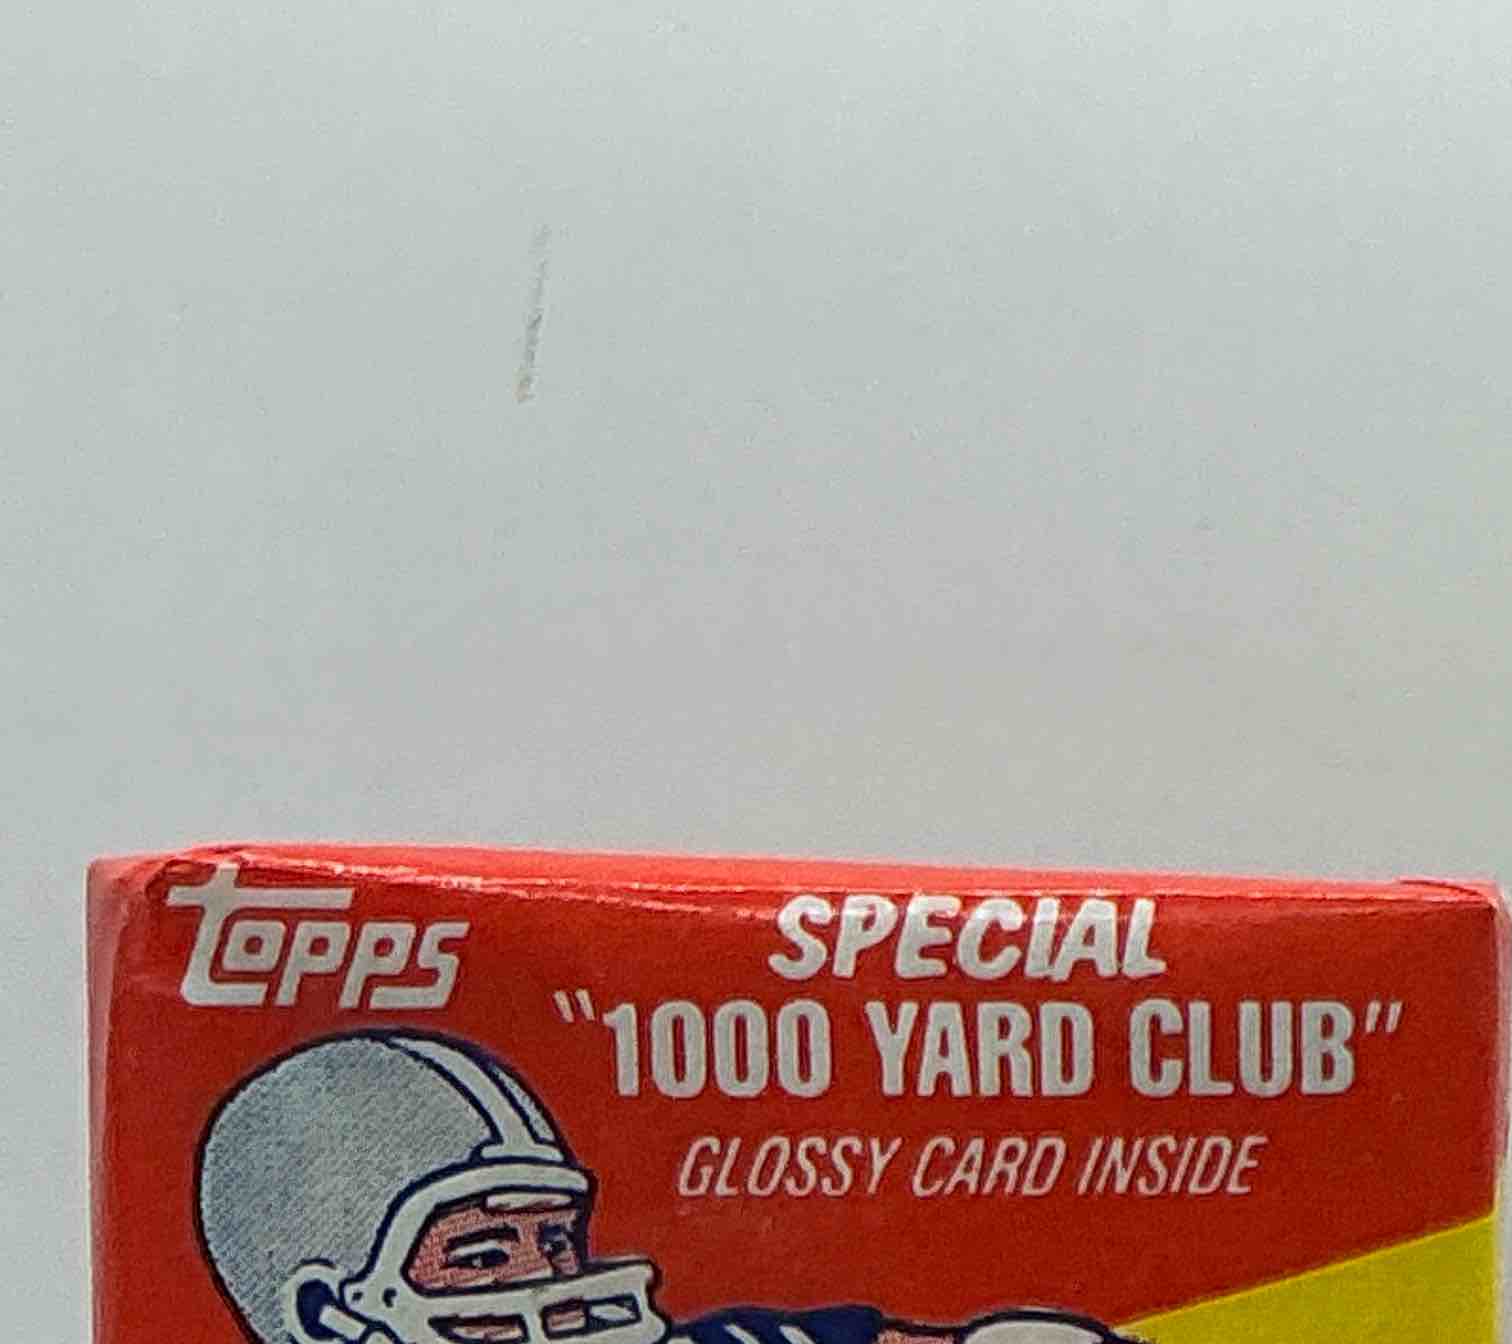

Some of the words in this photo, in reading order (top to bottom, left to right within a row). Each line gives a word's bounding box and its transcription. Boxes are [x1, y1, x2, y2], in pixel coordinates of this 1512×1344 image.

[768, 893, 1167, 981] SPECIAL
[553, 987, 833, 1098] "1000
[865, 1000, 1094, 1098] YARD
[1128, 998, 1402, 1098] CLUB"
[678, 1135, 901, 1198] GLOSSY
[912, 1135, 1066, 1197] CARD
[1078, 1135, 1268, 1196] INSIDE
